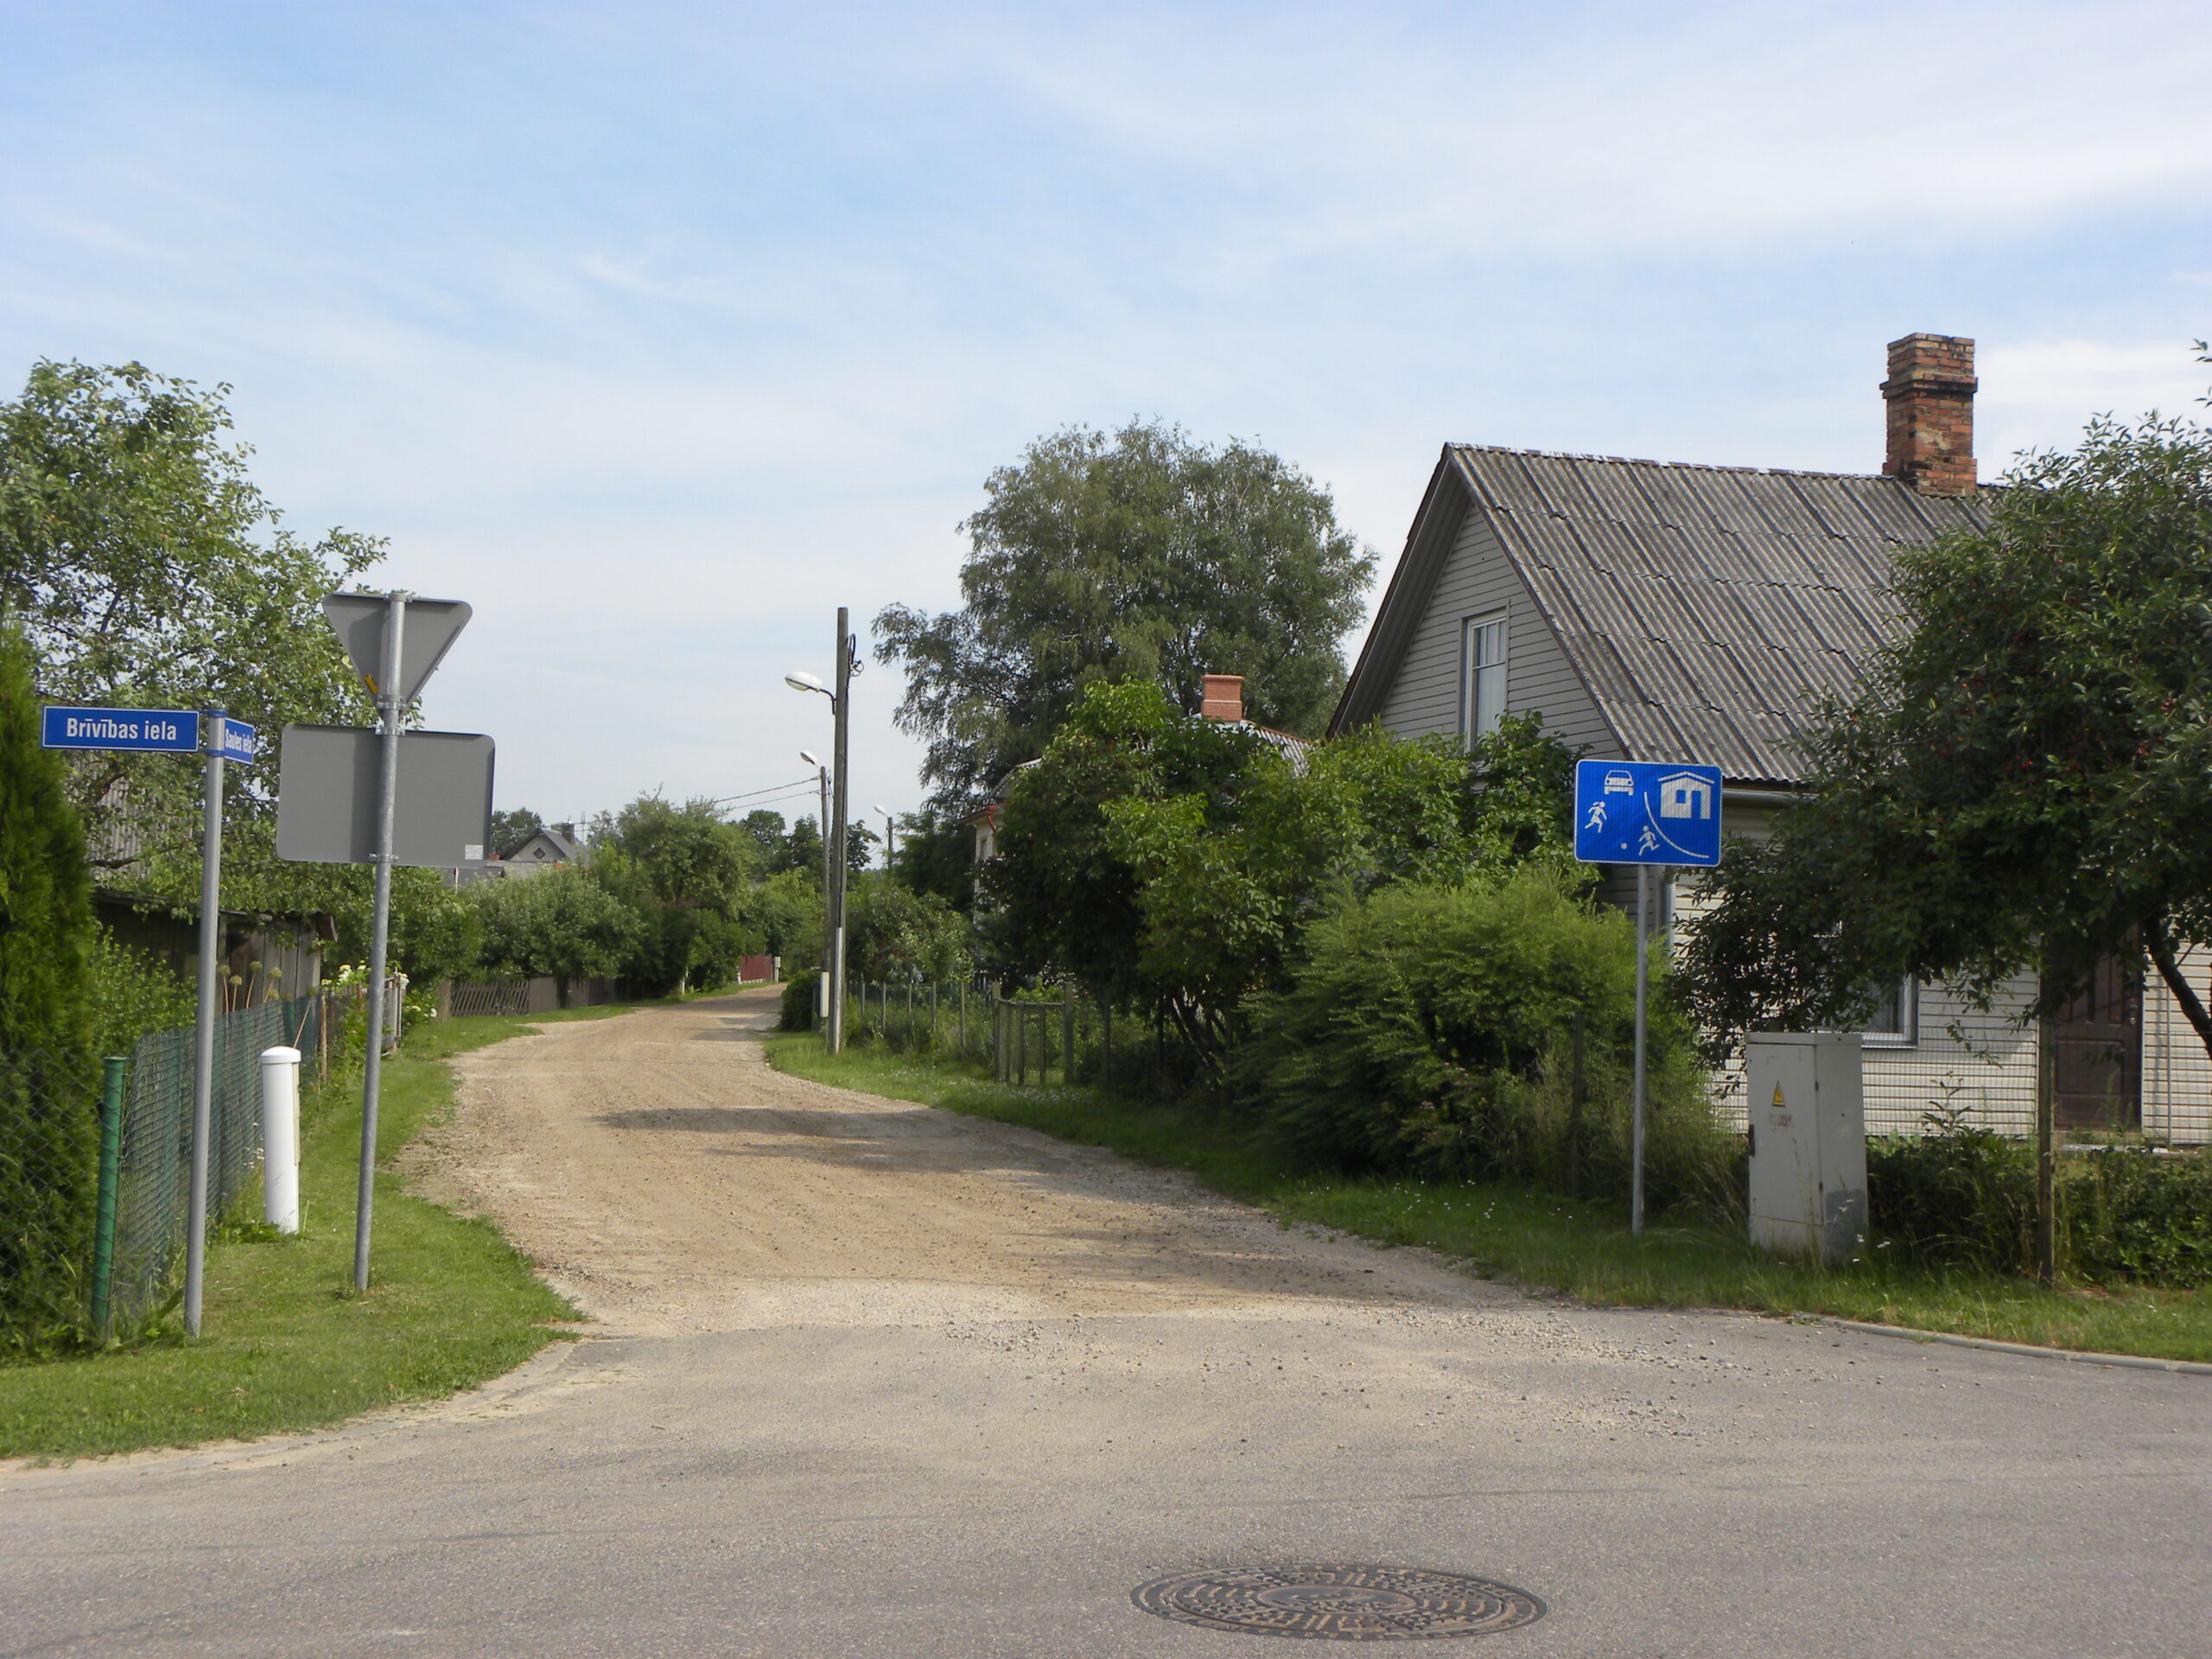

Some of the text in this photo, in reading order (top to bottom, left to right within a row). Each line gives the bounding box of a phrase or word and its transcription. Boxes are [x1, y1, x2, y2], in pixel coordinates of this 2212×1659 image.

[67, 717, 176, 741] Brīvības iela
[242, 734, 252, 754] iela
